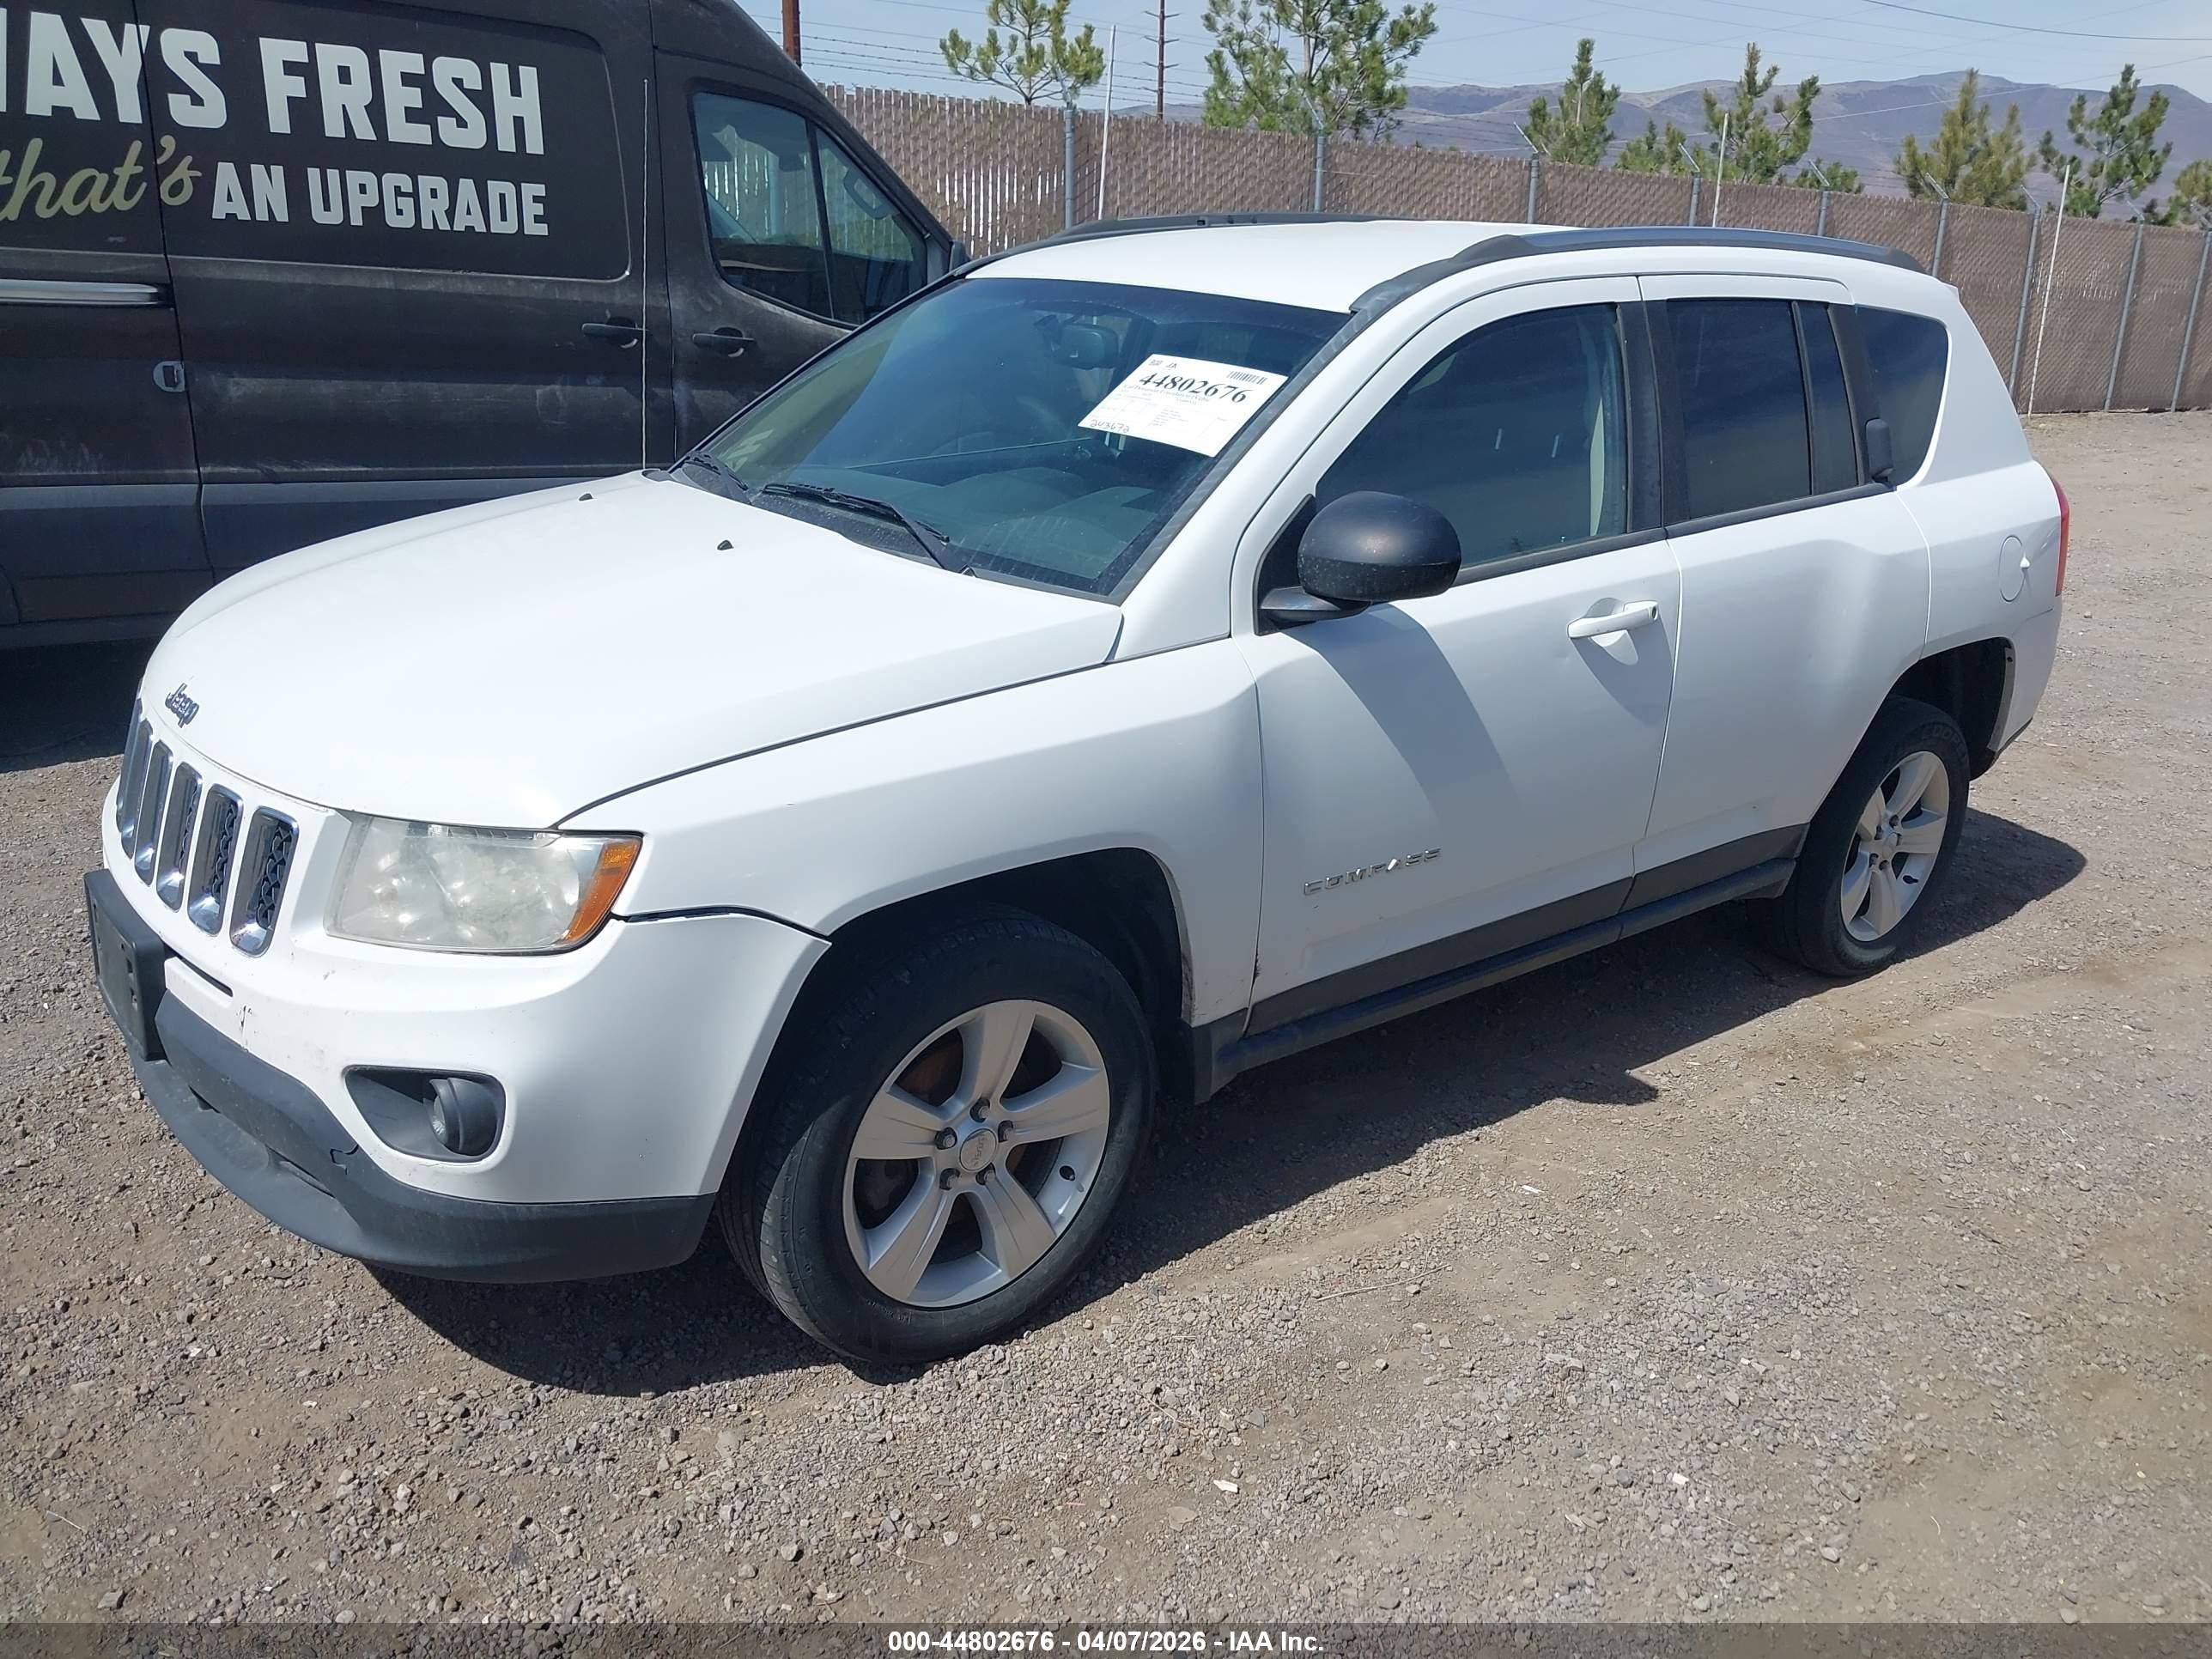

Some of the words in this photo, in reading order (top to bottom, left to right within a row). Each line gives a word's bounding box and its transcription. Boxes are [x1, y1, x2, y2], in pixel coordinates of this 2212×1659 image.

[0, 8, 228, 129] AYS
[259, 37, 544, 155] FRESH
[0, 135, 203, 222] that's
[212, 161, 289, 222] AN
[307, 167, 549, 236] UPGRADE
[1139, 372, 1254, 404] 44802676
[165, 683, 199, 728] Jeep
[1304, 847, 1442, 896] COMPASS
